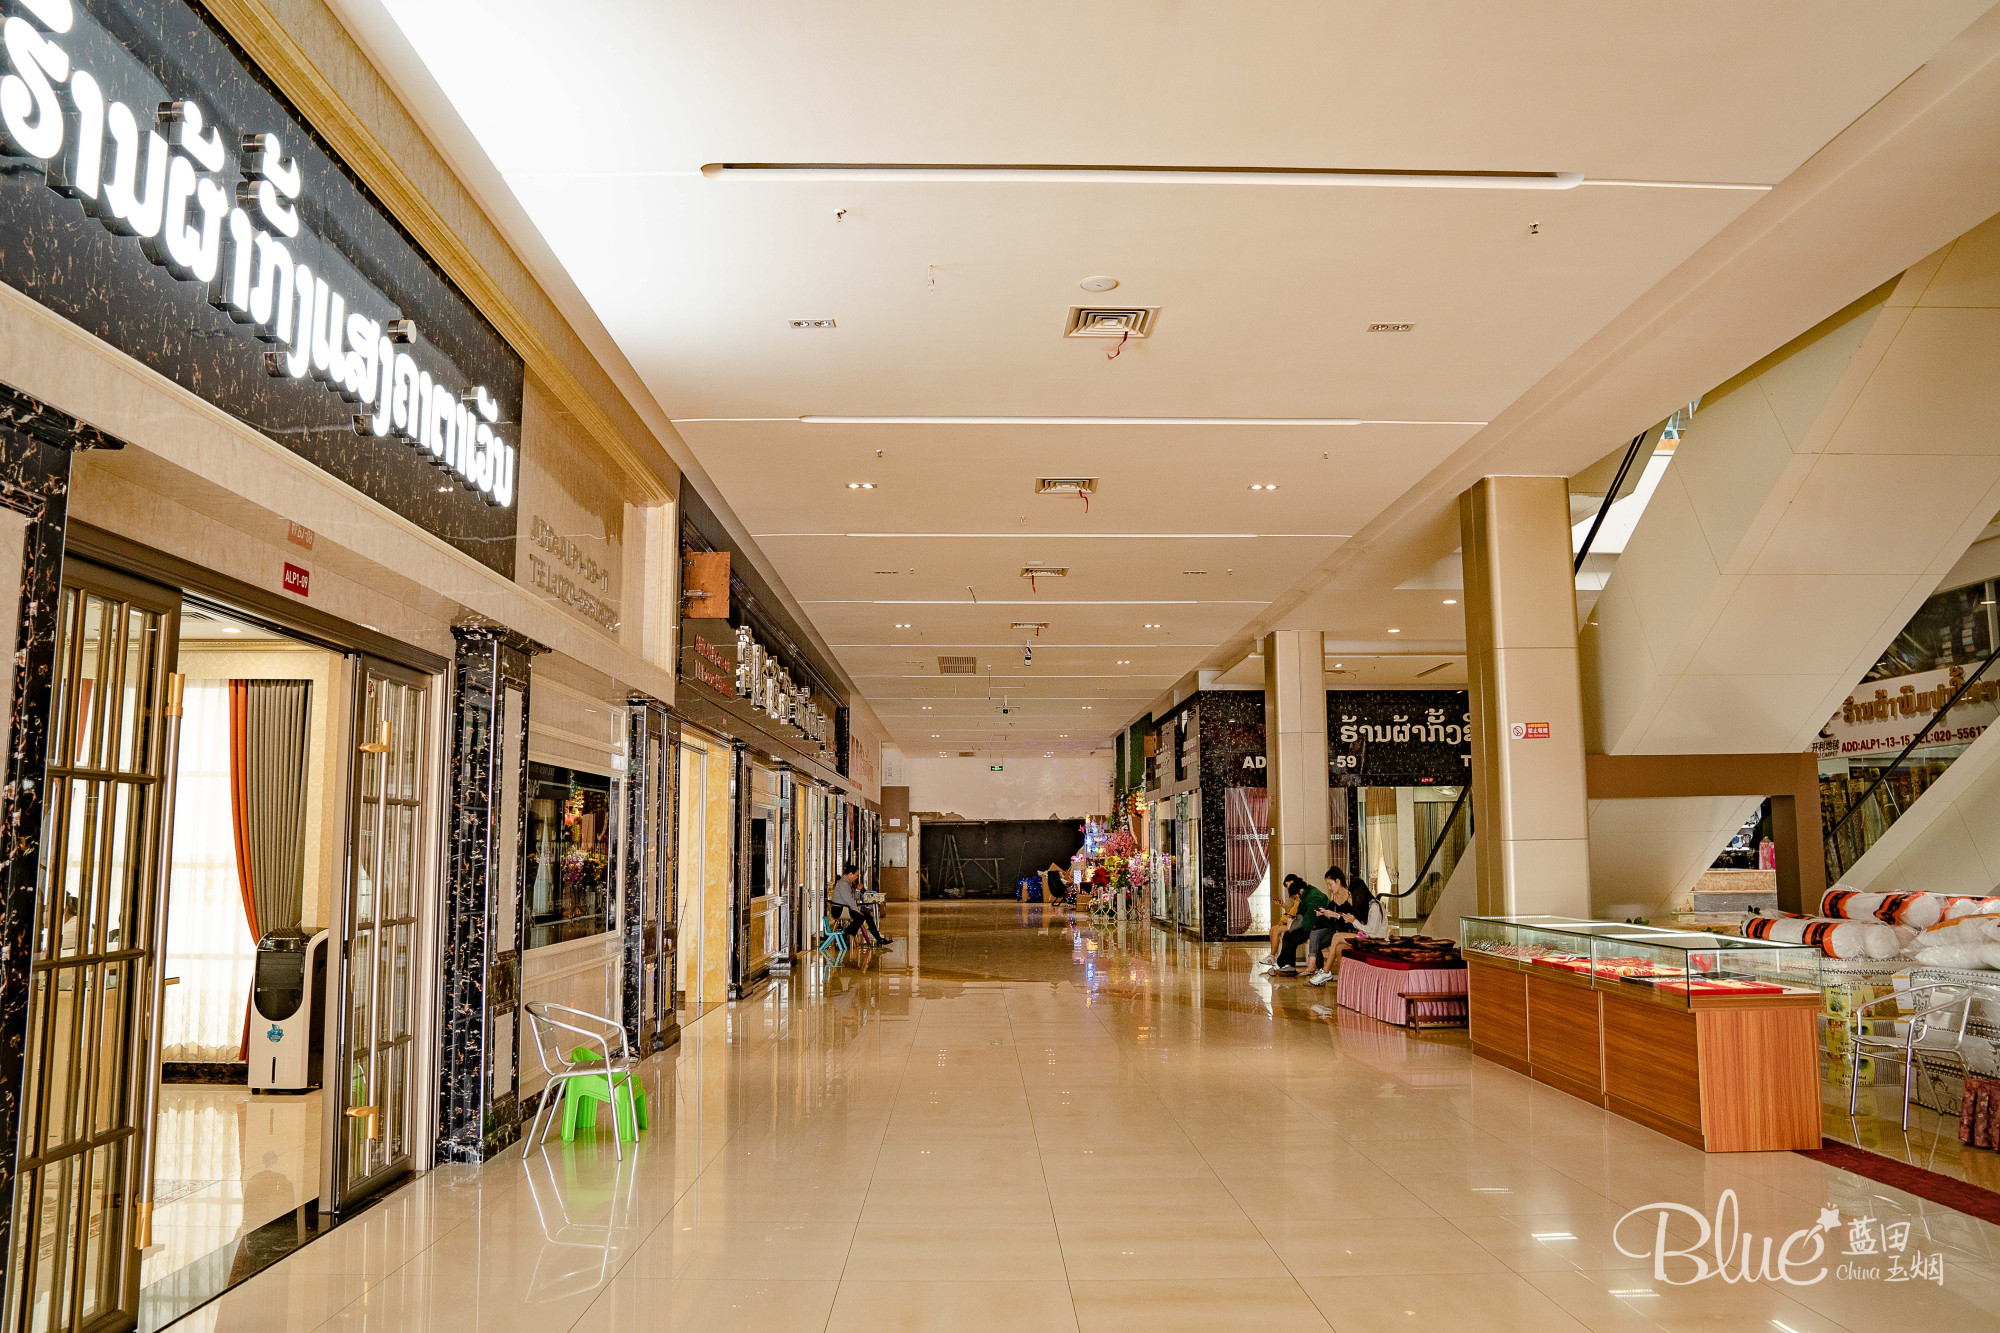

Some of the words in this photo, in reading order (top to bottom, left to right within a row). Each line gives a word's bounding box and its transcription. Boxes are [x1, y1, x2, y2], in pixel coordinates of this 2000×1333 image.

[285, 569, 308, 589] ALP1-09
[1912, 725, 1988, 746] TEL:020-55617
[1242, 756, 1267, 769] AD
[1330, 756, 1357, 768] -59
[1461, 754, 1471, 767] T
